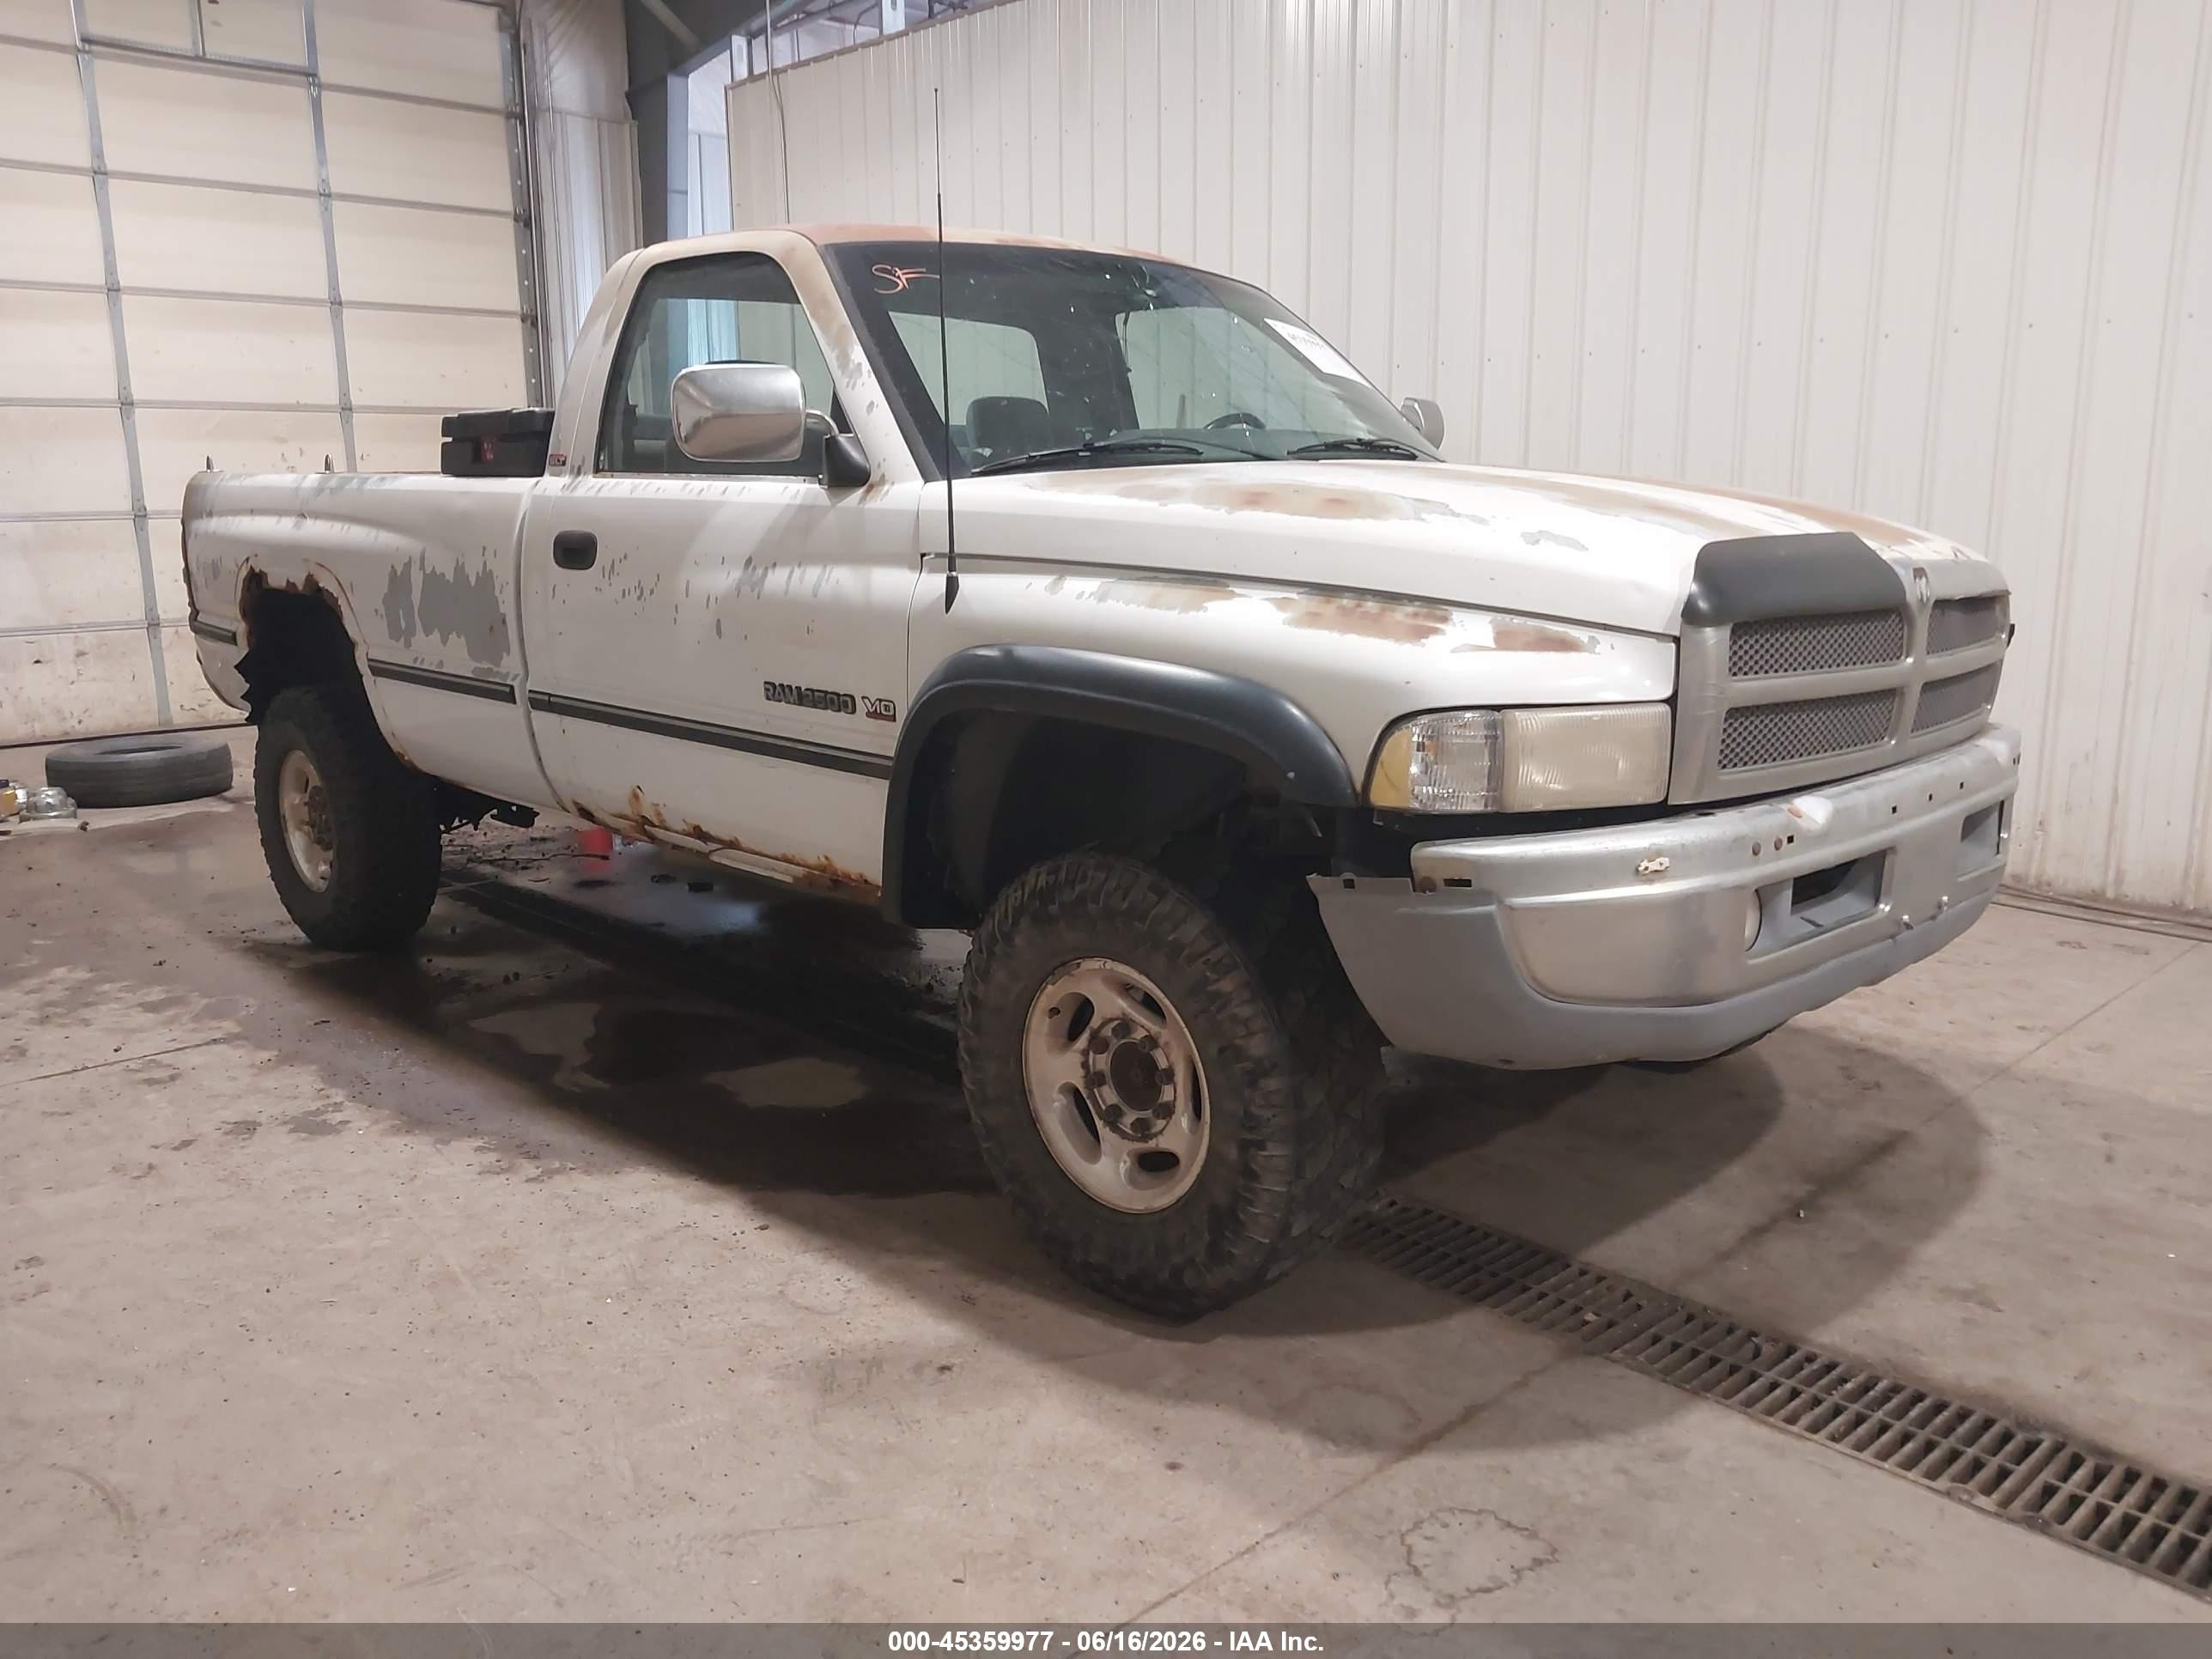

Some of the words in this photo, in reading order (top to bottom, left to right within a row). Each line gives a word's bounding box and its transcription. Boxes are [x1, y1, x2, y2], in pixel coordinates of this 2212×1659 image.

[763, 681, 802, 706] RAM
[801, 688, 857, 714] 2500
[861, 696, 896, 718] V10
